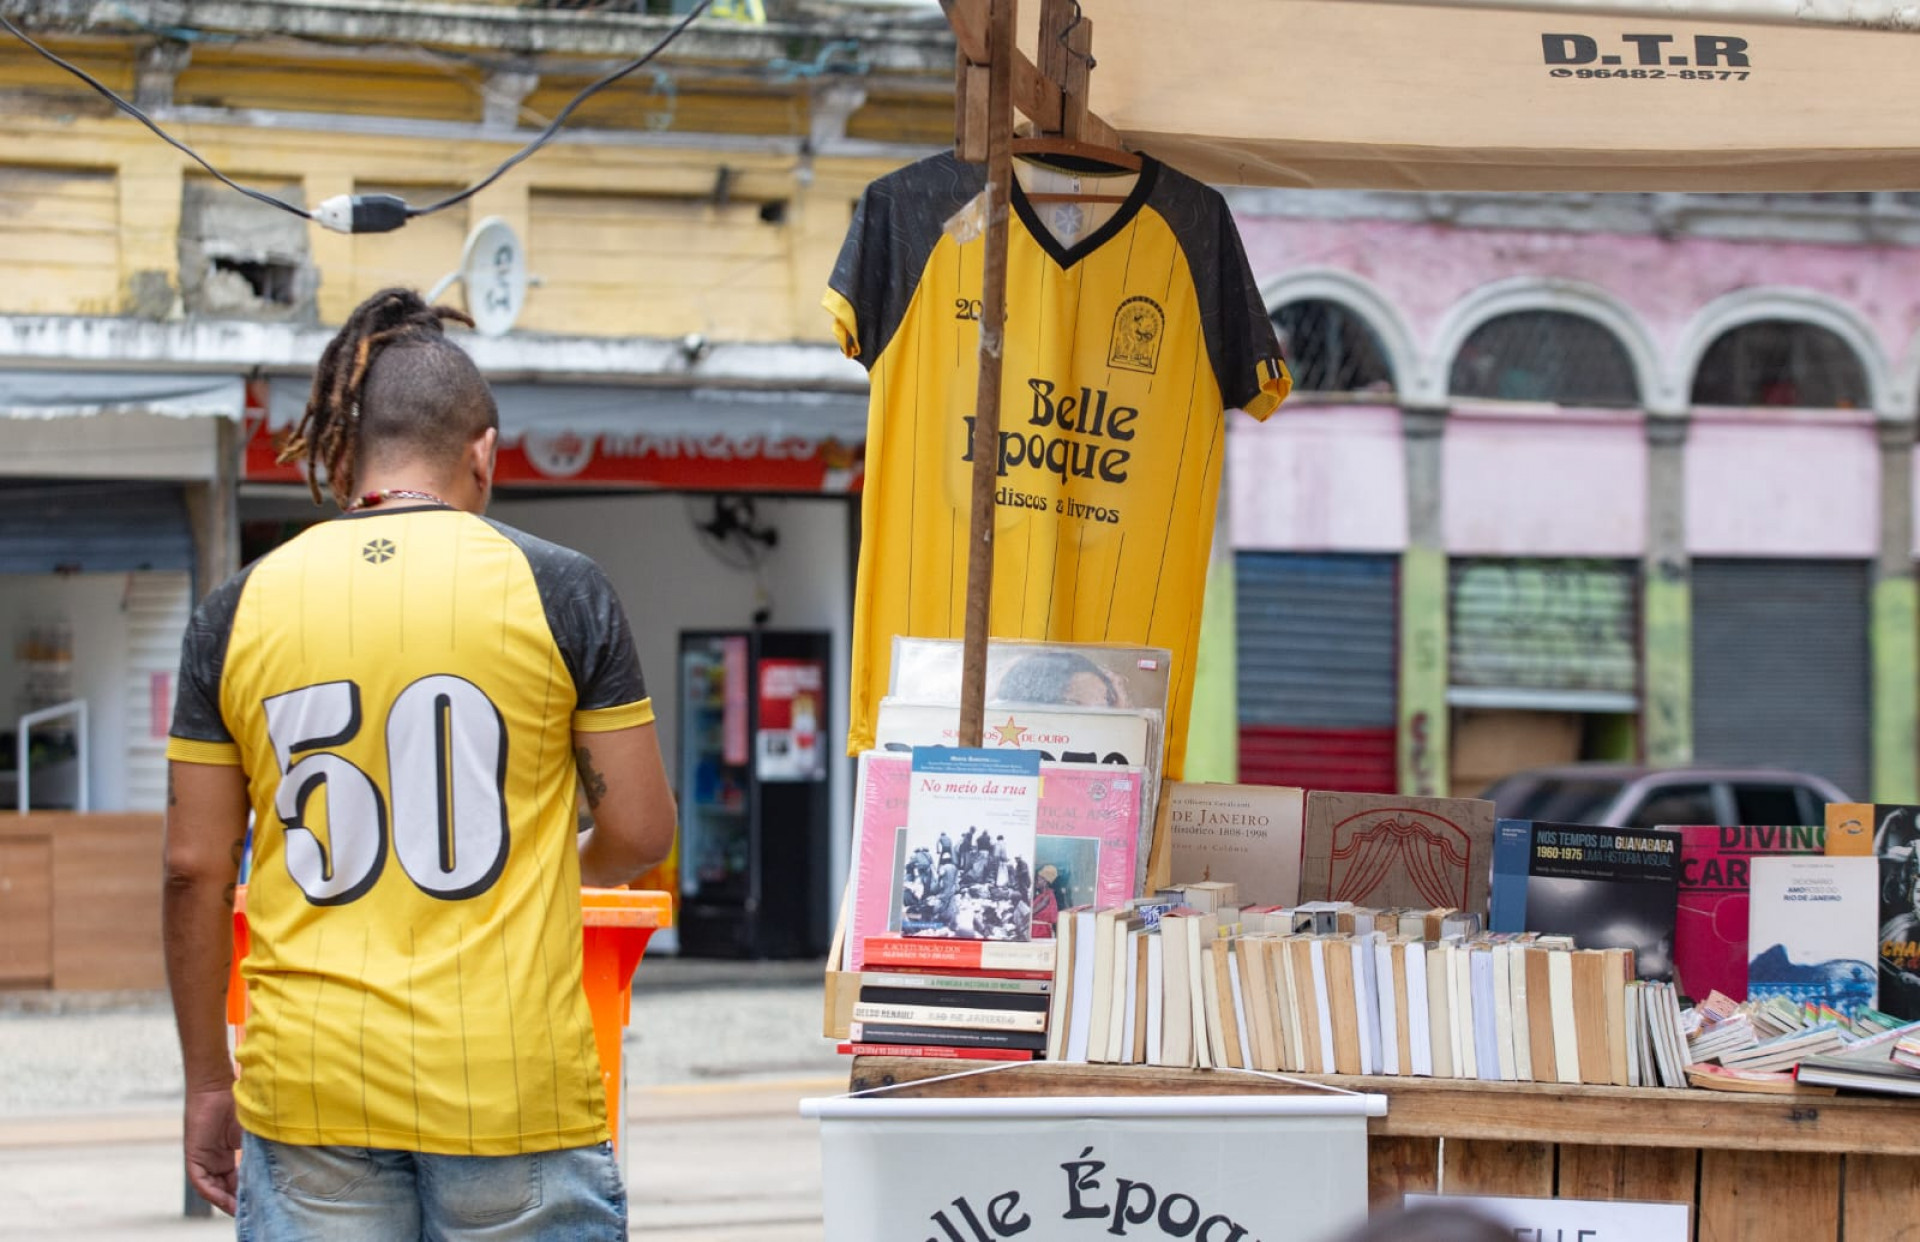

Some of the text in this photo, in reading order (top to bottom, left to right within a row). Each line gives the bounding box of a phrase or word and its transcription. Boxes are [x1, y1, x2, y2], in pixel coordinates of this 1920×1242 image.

[1541, 33, 1751, 67] D.T.R
[1575, 69, 1751, 81] 96482-8577
[955, 298, 1008, 322] 20
[1028, 378, 1139, 442] Belle
[995, 487, 1047, 511] discos
[1067, 497, 1120, 524] livros
[1038, 735, 1070, 744] OURO
[261, 673, 510, 907] 50
[920, 778, 1027, 795] No meio da rua
[1172, 809, 1270, 827] DE JANEIRO
[1536, 831, 1556, 845] NOS
[1559, 832, 1598, 848] TEMPOS
[1599, 836, 1614, 849] DA
[1614, 836, 1675, 854] GUANABARA
[1536, 845, 1583, 861] 1960-1975
[1680, 857, 1750, 886] CAR
[925, 1146, 1262, 1242] lle Époq
